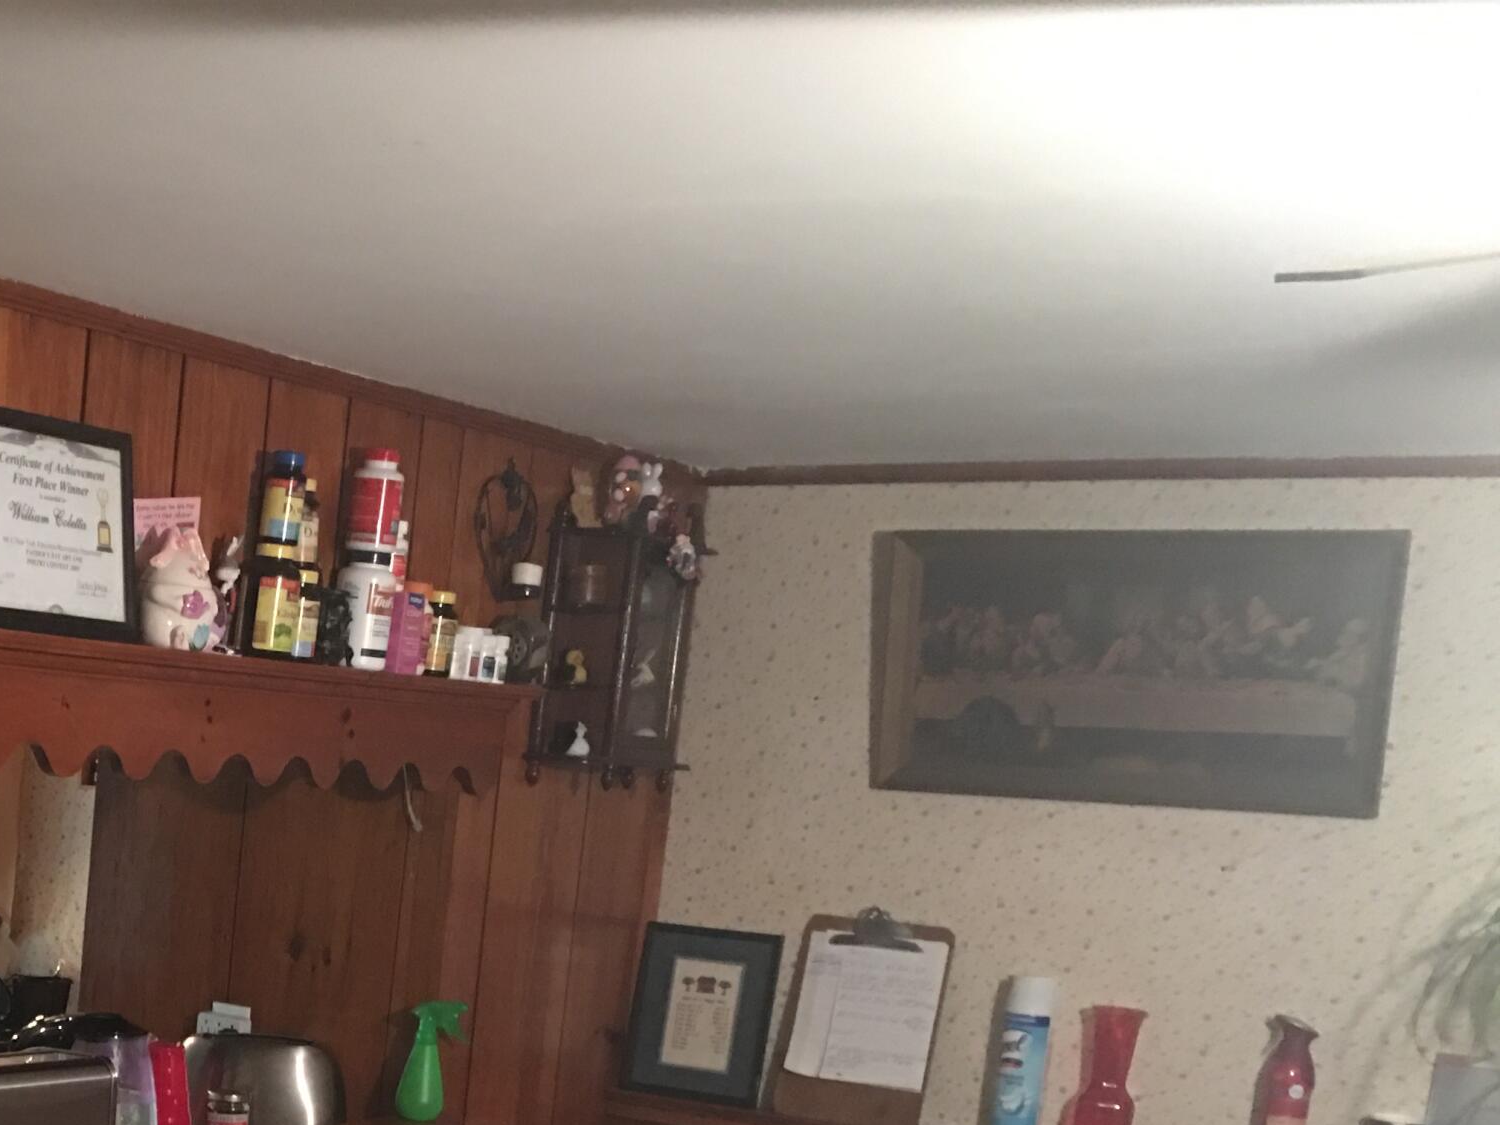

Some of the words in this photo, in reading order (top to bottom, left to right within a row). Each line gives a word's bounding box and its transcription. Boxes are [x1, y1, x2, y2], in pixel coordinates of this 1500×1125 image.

[43, 461, 53, 475] of
[56, 463, 105, 481] Achievement
[12, 472, 33, 487] First
[35, 476, 58, 491] Place
[60, 480, 90, 496] Winner
